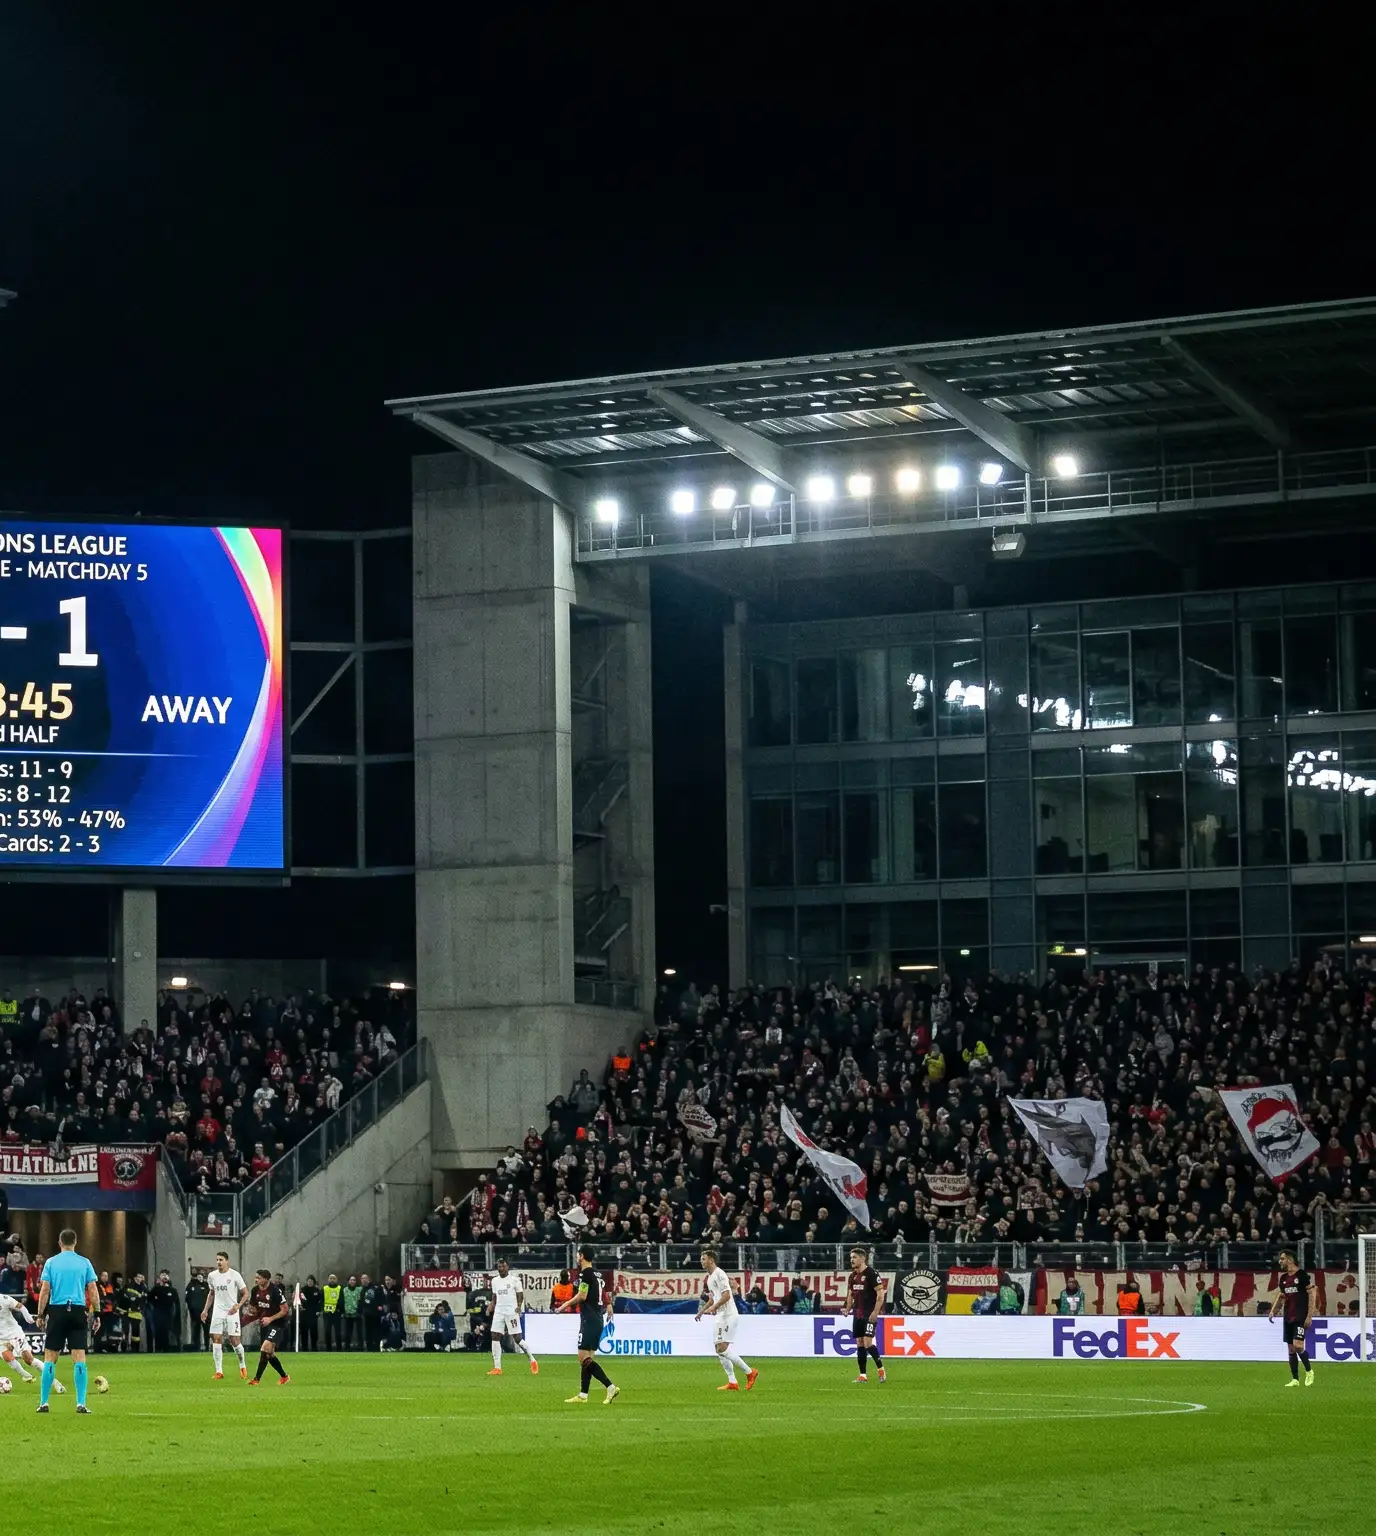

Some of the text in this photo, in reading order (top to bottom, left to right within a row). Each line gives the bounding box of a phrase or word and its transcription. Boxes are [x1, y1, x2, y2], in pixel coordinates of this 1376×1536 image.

[41, 534, 128, 556] LEAGUE
[28, 560, 131, 581] MATCHDAY
[136, 563, 148, 581] 5
[0, 626, 28, 640] -
[58, 596, 99, 667] 1
[141, 694, 233, 724] AWAY
[10, 724, 60, 743] HALF
[20, 760, 42, 778] 11
[60, 760, 73, 779] 9
[16, 784, 30, 803] 8
[48, 785, 71, 803] 12
[17, 809, 63, 828] 53%
[79, 810, 126, 829] 47%
[59, 834, 71, 853] 2
[88, 835, 100, 853] 3
[813, 1316, 936, 1356] FeEx
[1052, 1318, 1181, 1359] FedEx
